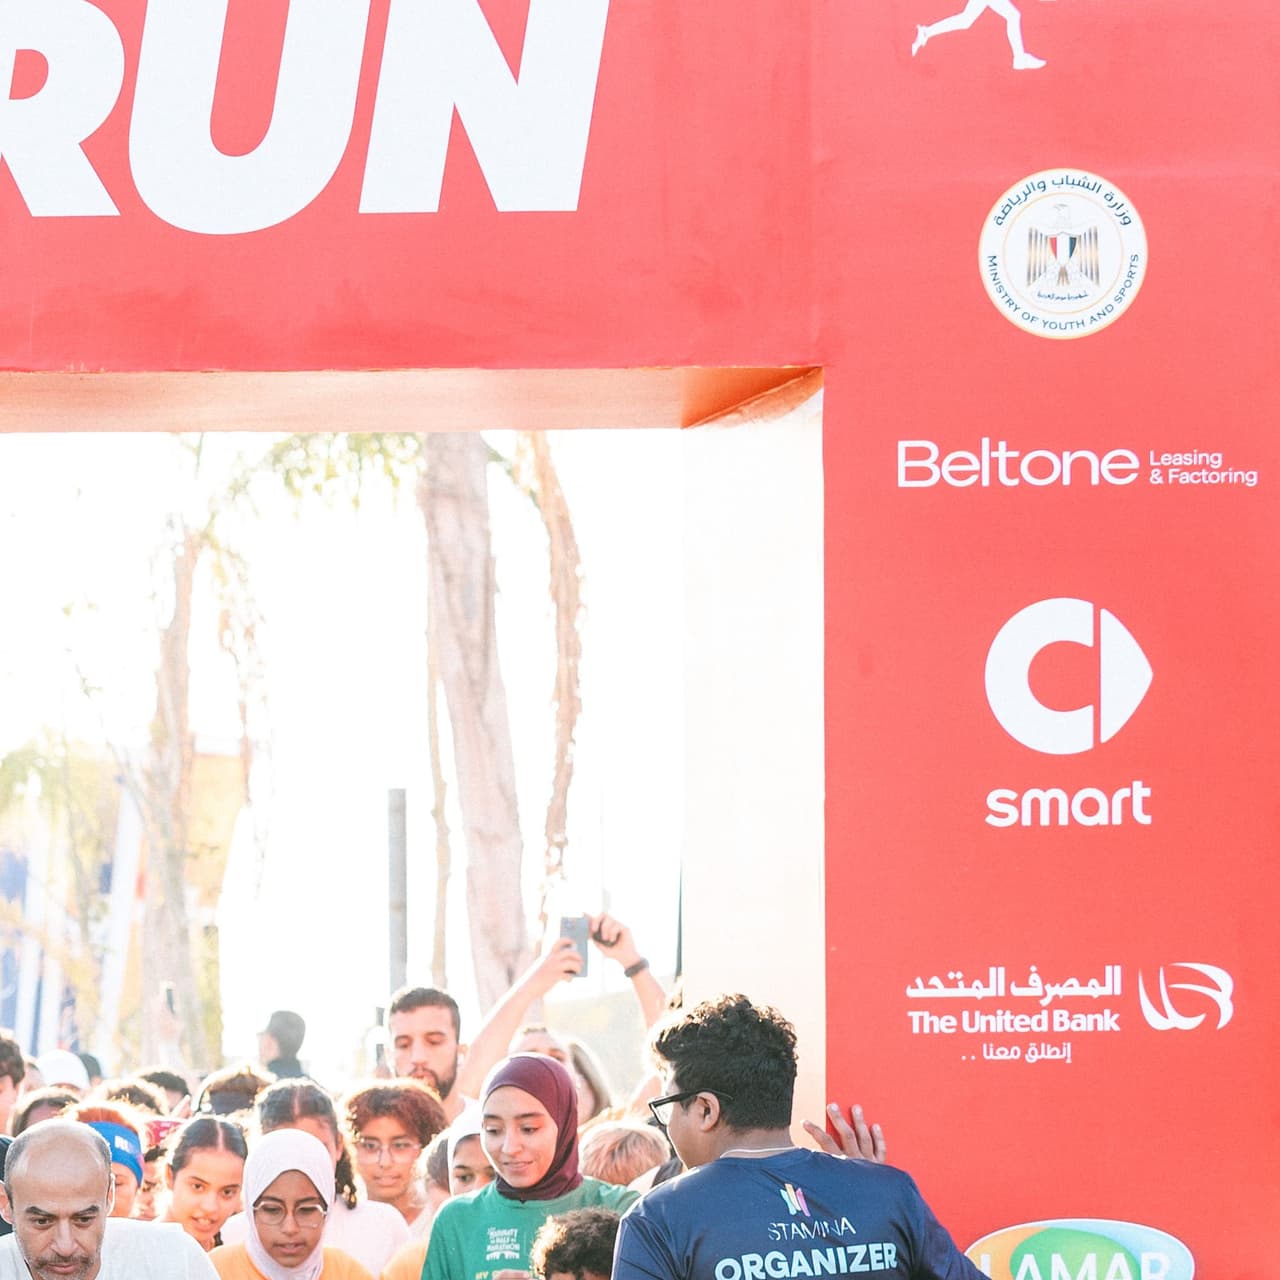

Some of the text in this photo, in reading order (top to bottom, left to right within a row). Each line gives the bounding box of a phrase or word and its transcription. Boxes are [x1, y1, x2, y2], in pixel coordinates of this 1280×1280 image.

[987, 254, 1022, 314] MINISTRY
[1021, 311, 1039, 325] OF
[1042, 319, 1086, 331] YOUTH
[1089, 303, 1115, 325] AND
[1114, 253, 1140, 304] SPORTS
[898, 437, 1140, 488] Beltone
[1149, 450, 1223, 468] Leasing
[1149, 467, 1259, 487] & Factoring
[984, 780, 1152, 828] smart
[905, 965, 1123, 1007] المصرف المتحد
[907, 1009, 1122, 1034] The United Bank
[767, 1217, 857, 1242] STAMINA
